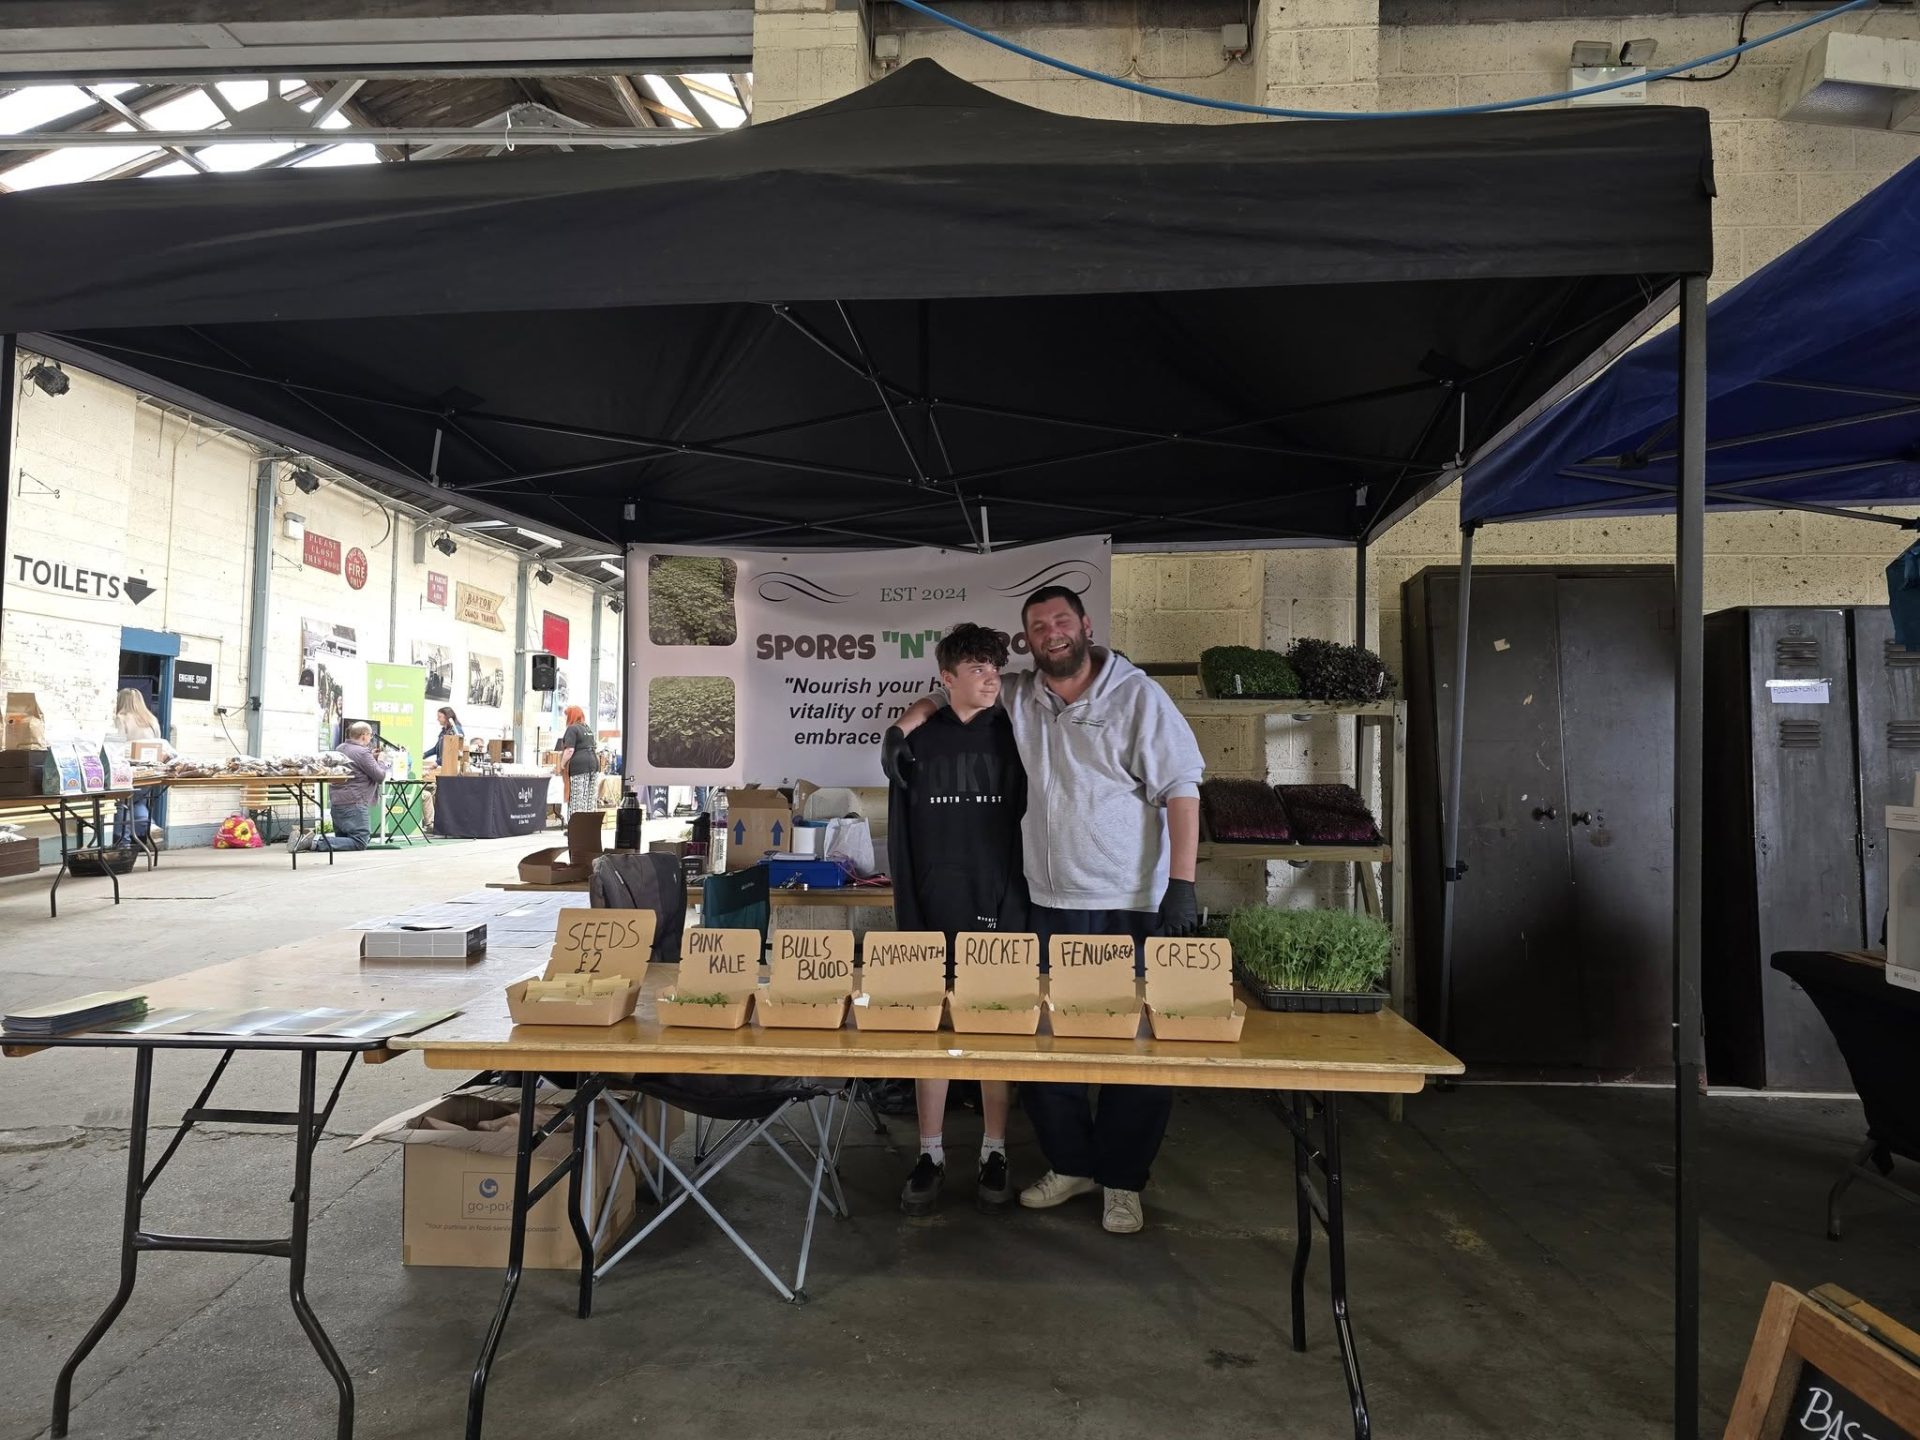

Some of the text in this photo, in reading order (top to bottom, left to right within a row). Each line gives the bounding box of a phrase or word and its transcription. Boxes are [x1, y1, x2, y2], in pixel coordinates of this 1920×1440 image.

[305, 553, 321, 564] THIS
[13, 554, 120, 599] TOILETS
[348, 563, 365, 579] FIRE
[880, 587, 968, 602] EST 2024
[178, 673, 195, 684] ENGINE
[784, 677, 872, 694] "Nourish
[877, 680, 924, 698] your
[789, 703, 856, 723] vitality
[861, 703, 884, 719] of
[794, 729, 882, 745] embrace
[930, 796, 960, 804] SOUTH
[976, 795, 1002, 803] WEST
[565, 920, 640, 952] SEEDS
[689, 933, 724, 955] PINK
[781, 935, 832, 960] BULLS
[869, 944, 945, 968] AMARANTH
[965, 937, 1035, 966] ROCKET
[1061, 941, 1134, 967] FENUGREEK
[1155, 942, 1222, 970] CRESS
[574, 951, 601, 974] £2
[709, 954, 746, 974] KALE
[797, 959, 849, 981] BLOOD
[467, 1201, 512, 1214] go-pak
